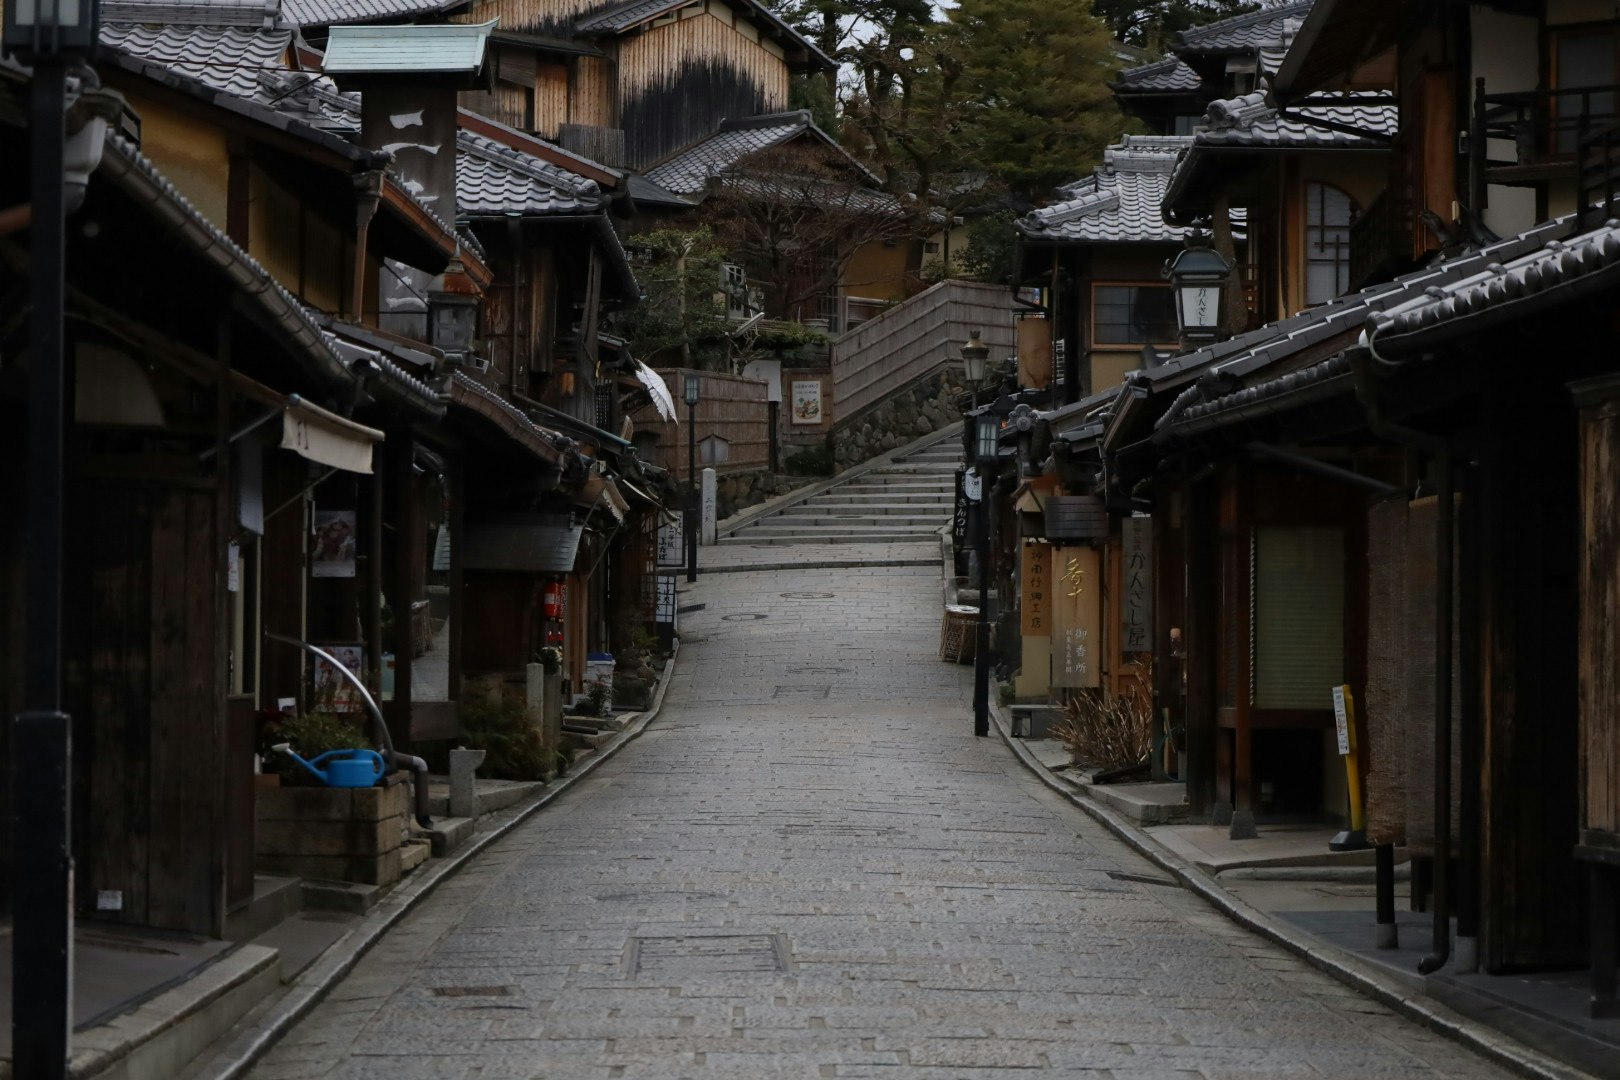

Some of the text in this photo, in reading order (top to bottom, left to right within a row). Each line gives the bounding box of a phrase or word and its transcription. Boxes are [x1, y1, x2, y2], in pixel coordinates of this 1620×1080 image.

[1128, 552, 1146, 647] かんざし屋
[1075, 628, 1088, 674] 御香所
